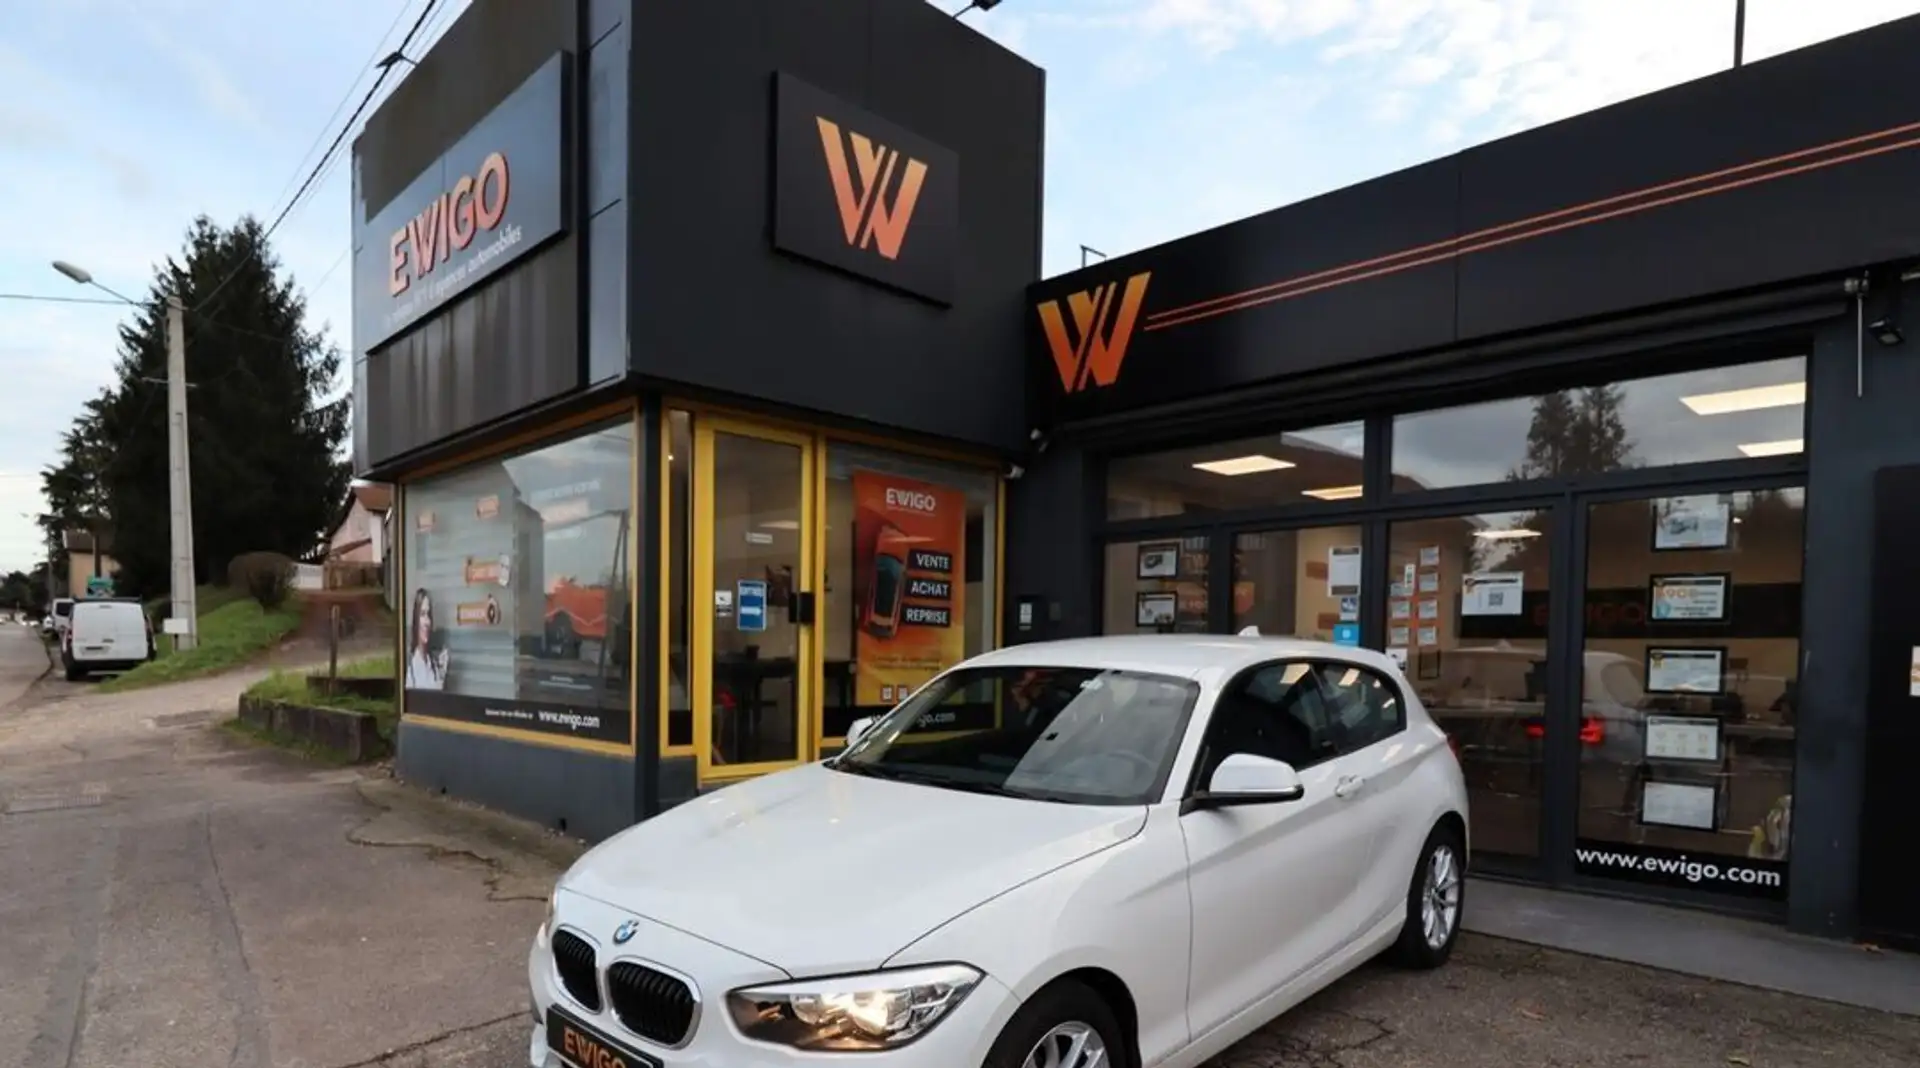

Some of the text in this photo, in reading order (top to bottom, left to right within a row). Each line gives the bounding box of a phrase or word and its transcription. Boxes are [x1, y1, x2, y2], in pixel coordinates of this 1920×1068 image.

[390, 152, 509, 297] EWIGO
[886, 488, 936, 511] EWIGO
[916, 553, 949, 570] VENTE
[911, 581, 949, 597] ACHAT
[906, 608, 949, 625] REPRISE
[538, 709, 600, 731] www.ewigo.com
[1576, 848, 1781, 887] www.ewigo.com
